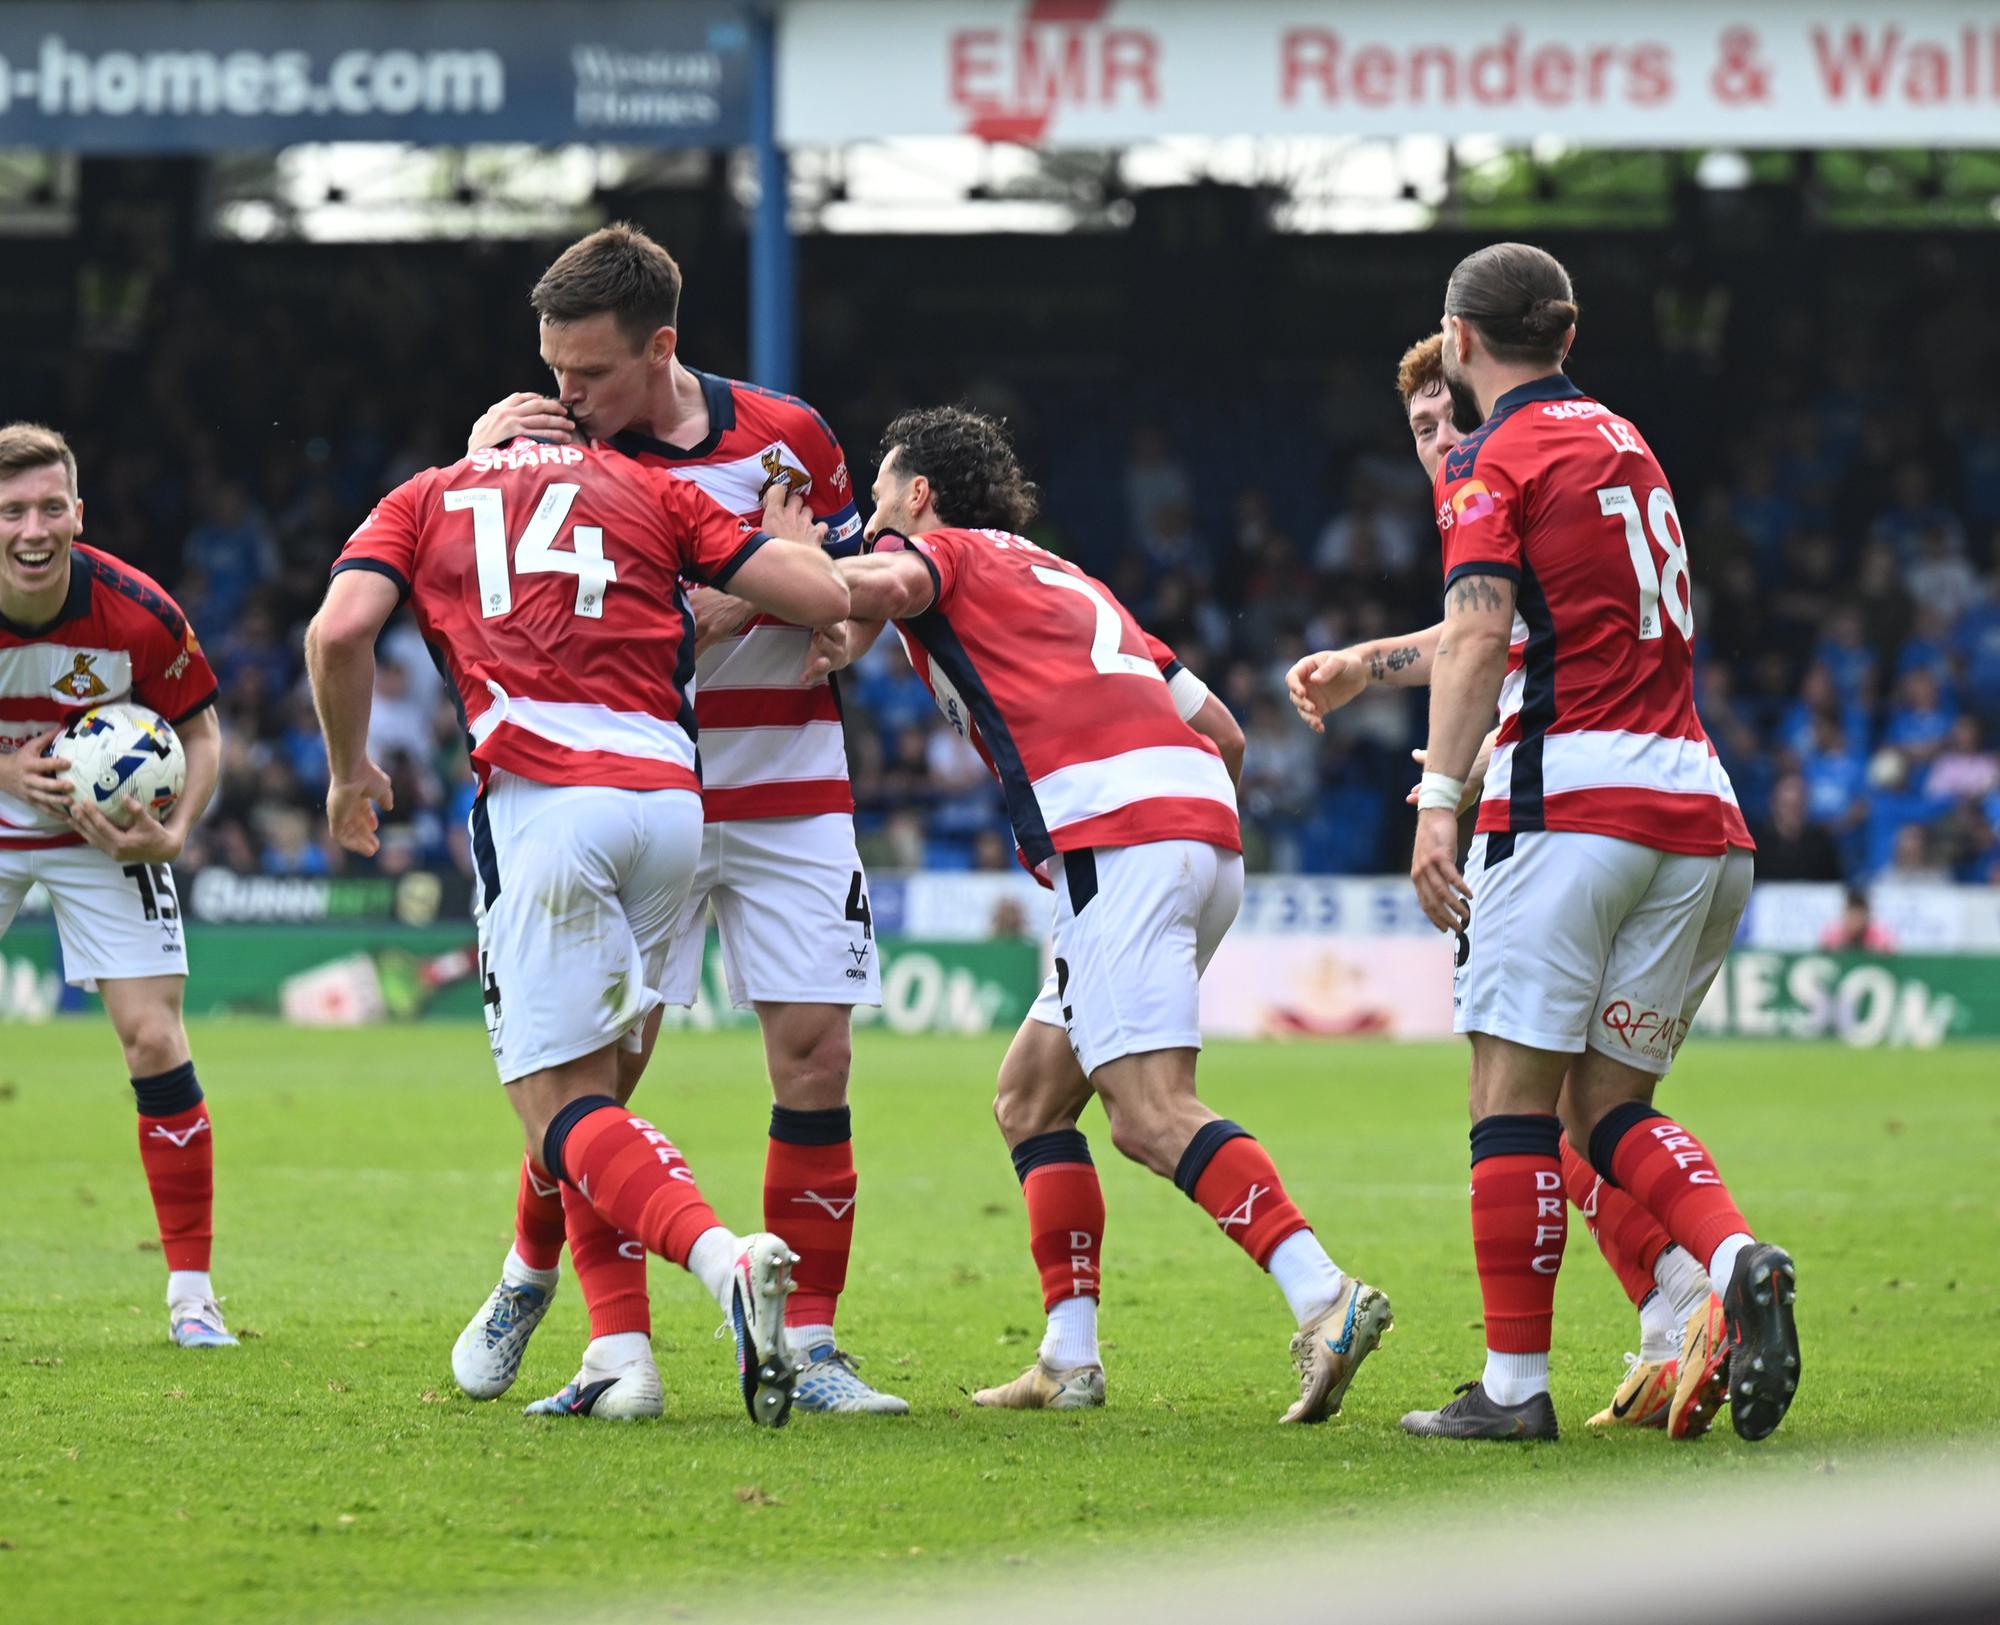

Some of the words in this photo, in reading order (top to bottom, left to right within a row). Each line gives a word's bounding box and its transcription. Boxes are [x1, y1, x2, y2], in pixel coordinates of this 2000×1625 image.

[0, 37, 502, 116] -homes.com
[949, 28, 1164, 107] EMR
[1280, 25, 1675, 107] Renders
[1711, 24, 1774, 106] &
[472, 446, 584, 472] SHARP
[444, 482, 617, 619] 14
[1597, 485, 1694, 641] 18
[1033, 564, 1166, 683] 2
[122, 863, 178, 921] 15
[845, 870, 872, 940] 4
[1650, 1124, 1721, 1185] DRFC
[1531, 1171, 1564, 1275] DRFC
